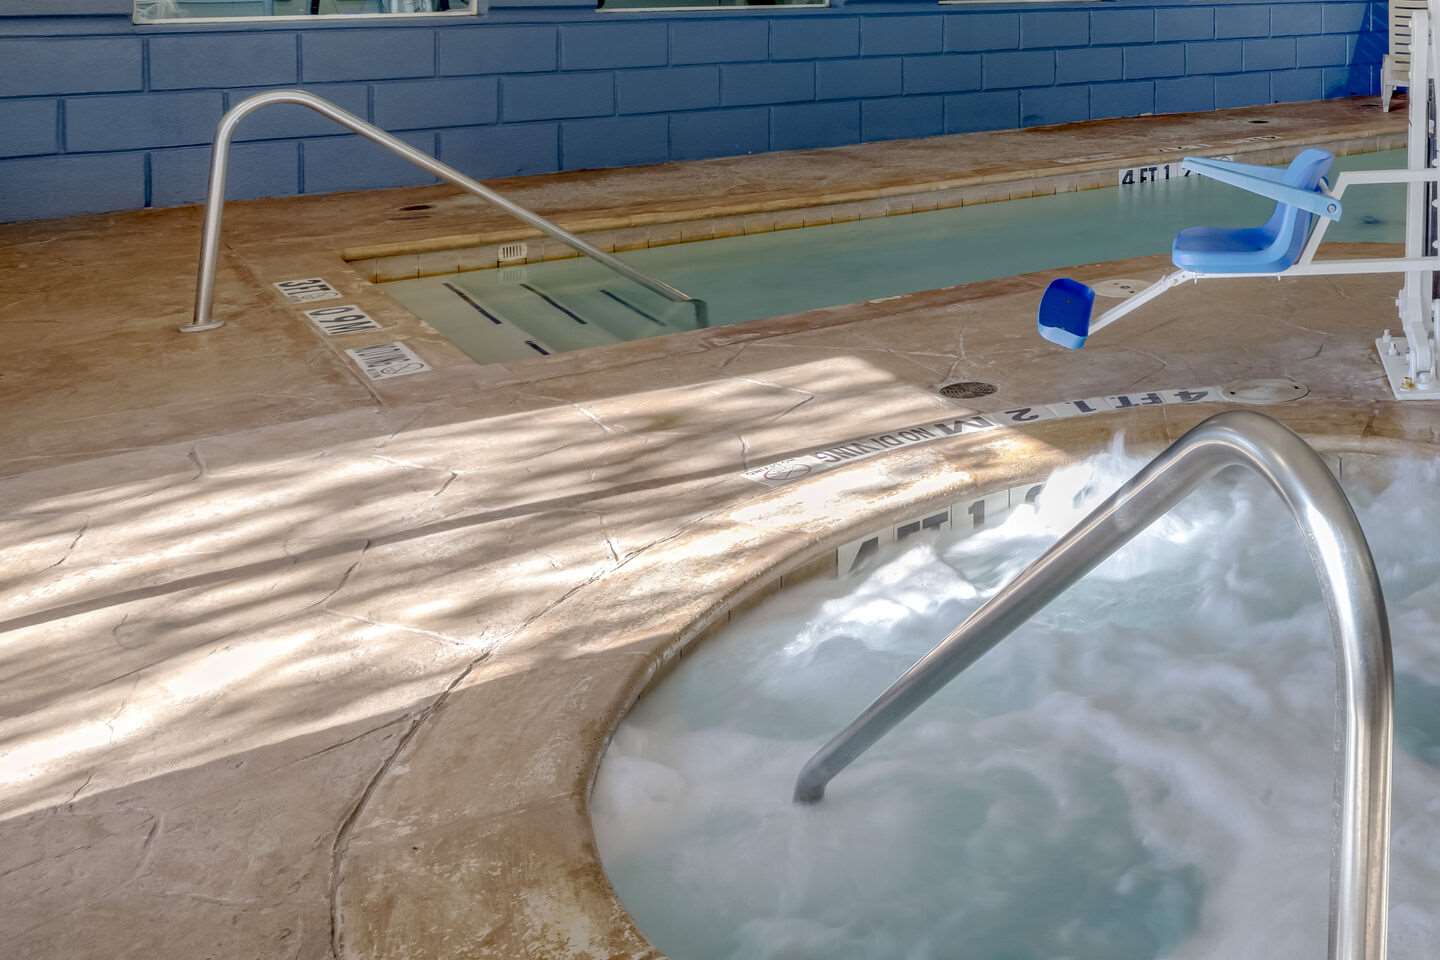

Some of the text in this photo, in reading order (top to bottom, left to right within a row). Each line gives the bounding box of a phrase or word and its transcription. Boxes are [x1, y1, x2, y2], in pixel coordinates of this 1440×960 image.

[1122, 169, 1135, 185] 4
[1140, 166, 1157, 184] FT
[1173, 390, 1208, 402] 4
[898, 427, 936, 441] NO
[815, 434, 904, 463] DIVING
